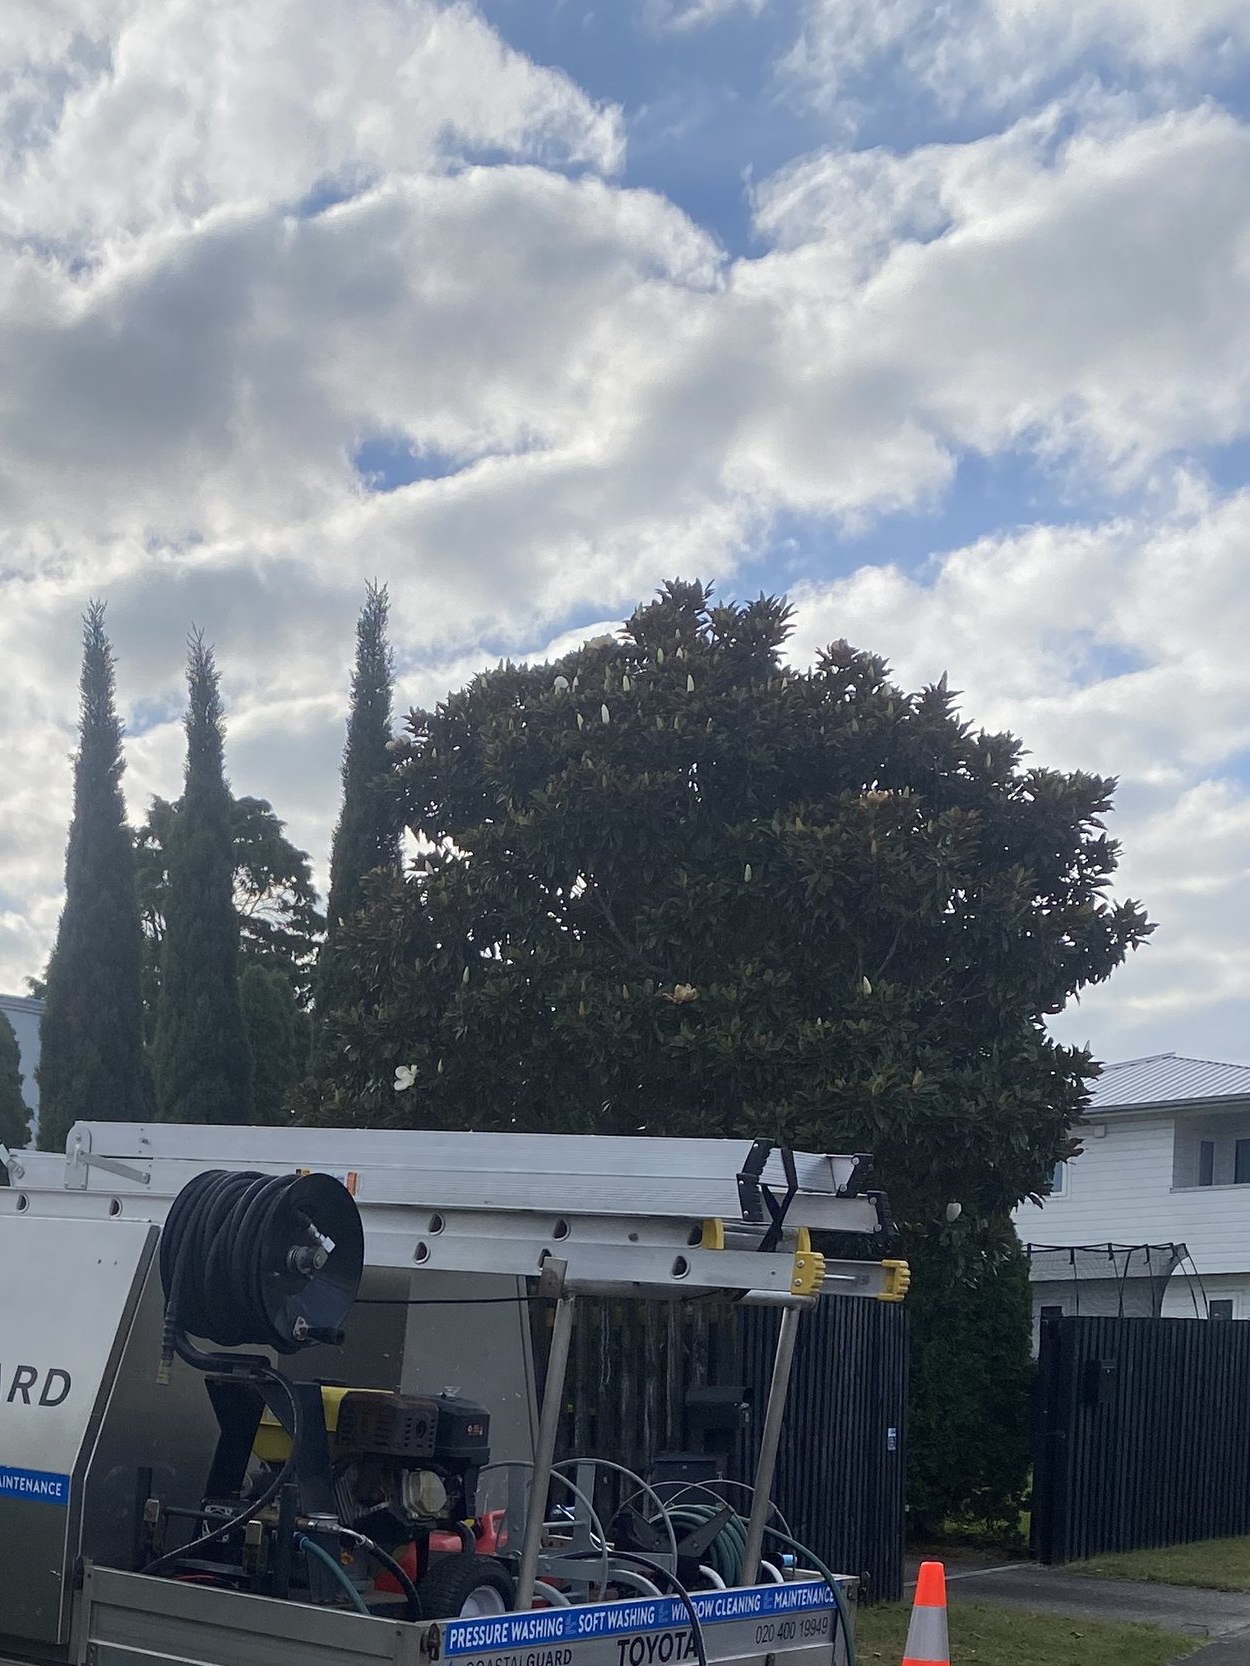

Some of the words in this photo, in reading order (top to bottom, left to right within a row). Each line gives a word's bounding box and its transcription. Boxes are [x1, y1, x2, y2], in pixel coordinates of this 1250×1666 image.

[449, 1622, 509, 1650] PRESSURE
[511, 1617, 564, 1642] WASHING
[578, 1611, 606, 1633] SOFT
[607, 1605, 655, 1629] WASHING
[715, 1594, 761, 1619] CLEANING
[755, 1624, 775, 1644] 020
[777, 1621, 796, 1640] 400
[800, 1616, 829, 1637] 19949
